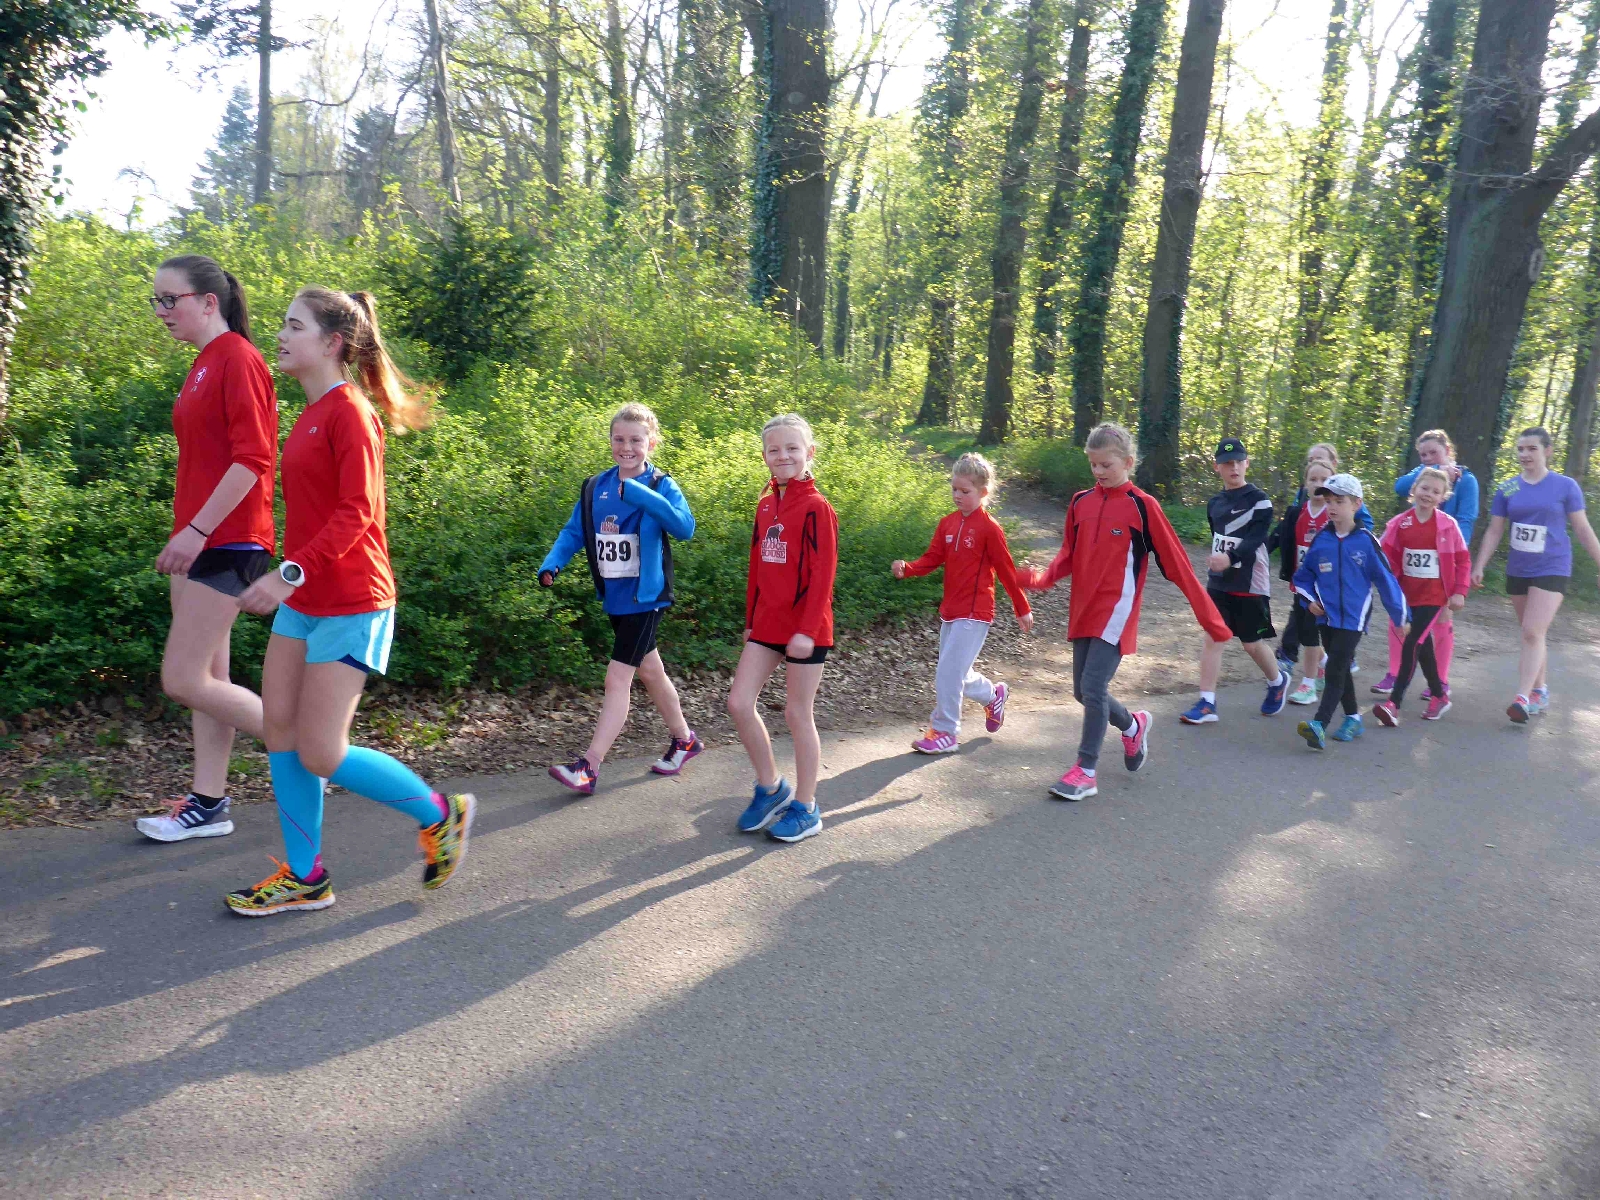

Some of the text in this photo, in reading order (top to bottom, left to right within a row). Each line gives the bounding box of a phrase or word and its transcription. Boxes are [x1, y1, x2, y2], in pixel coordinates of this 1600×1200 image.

[1515, 526, 1537, 542] 257
[597, 540, 632, 562] 239
[1406, 552, 1431, 567] 232
